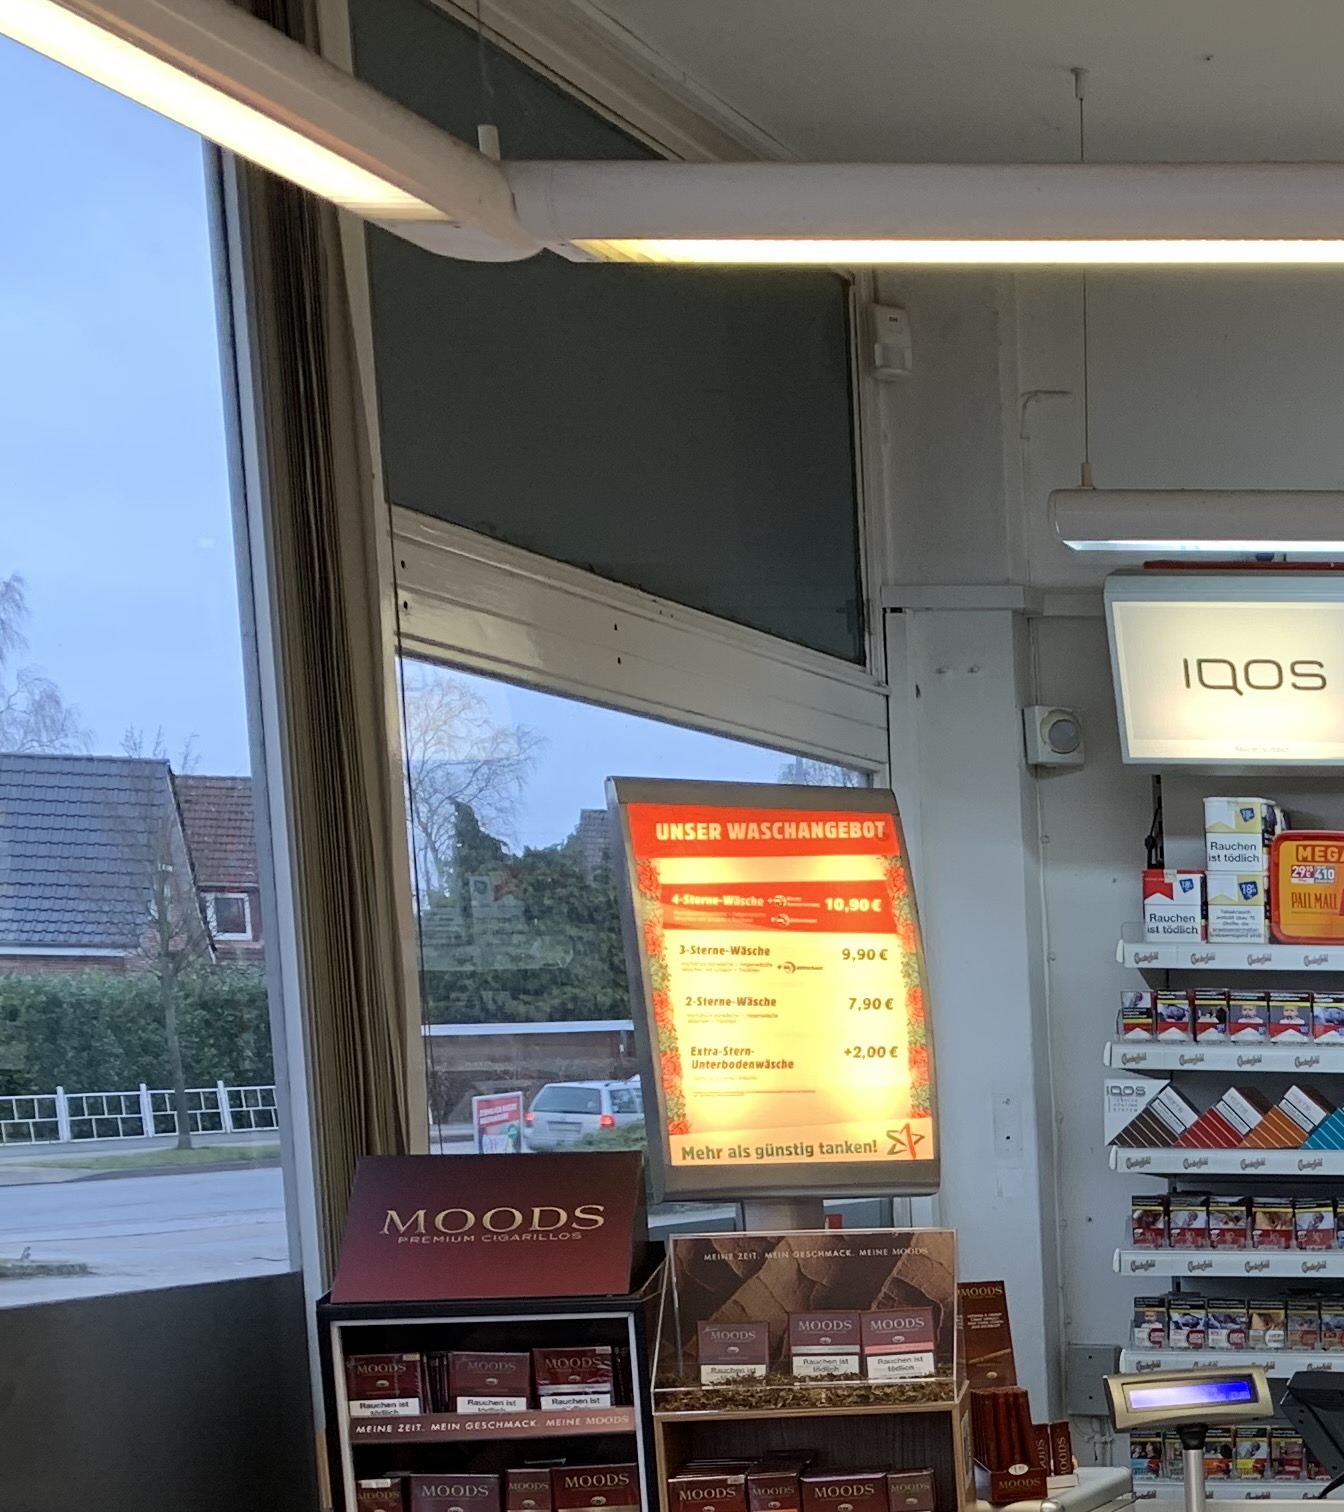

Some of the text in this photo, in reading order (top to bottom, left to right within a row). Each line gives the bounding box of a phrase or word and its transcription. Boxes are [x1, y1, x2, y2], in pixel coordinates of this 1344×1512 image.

[1183, 657, 1327, 697] IQOS
[656, 821, 885, 840] UNSER WASCHANGEBOT
[1210, 842, 1256, 851] Rauchen
[1208, 854, 1259, 864] ist tödlich
[672, 894, 764, 906] 4-Sterne-Wäsche
[1291, 892, 1338, 908] PALL MALL
[679, 945, 770, 956] 3-Sterne-Wäsche
[685, 996, 776, 1007] 2-Sterne-Wäsche
[690, 1046, 755, 1057] Extra-Stern-
[692, 1059, 794, 1070] Unterbodenwäsche
[682, 1140, 877, 1160] Mehr als günstig tanken!
[379, 1205, 606, 1234] MOODS
[398, 1232, 582, 1244] PREMIUM CIGARILLOS
[356, 1425, 392, 1433] MEINE
[546, 1418, 580, 1427] MEINE
[586, 1416, 629, 1424] MOODS
[565, 1474, 630, 1488] MOODS
[814, 1484, 874, 1497] MOODS
